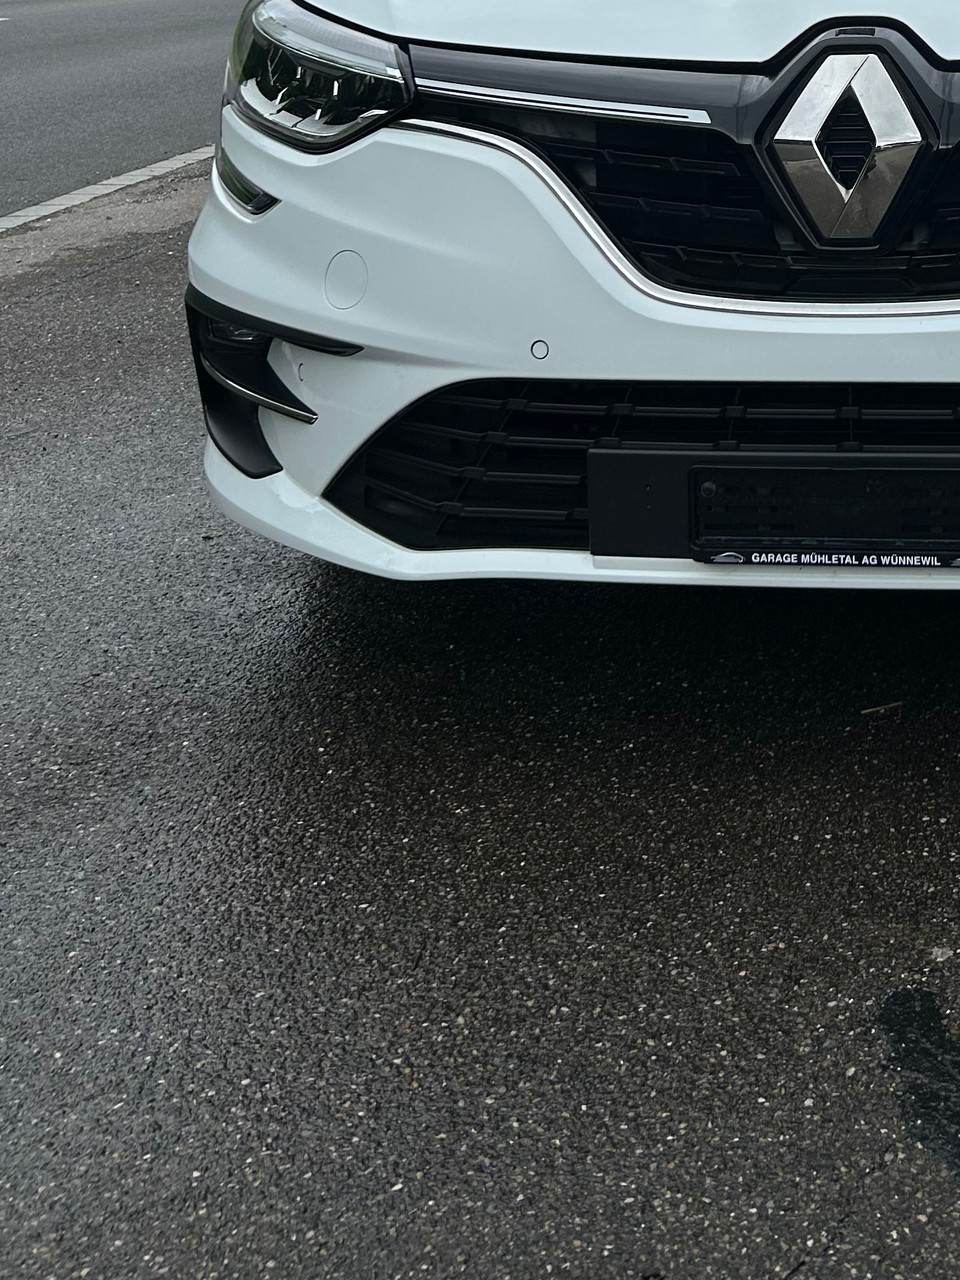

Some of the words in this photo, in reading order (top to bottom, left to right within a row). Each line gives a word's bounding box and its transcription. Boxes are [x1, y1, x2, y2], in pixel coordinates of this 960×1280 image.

[751, 552, 798, 564] GARAGE
[801, 551, 859, 565] MÜHLETAL
[861, 554, 878, 565] AG
[880, 553, 941, 567] WÜNNEWIL
